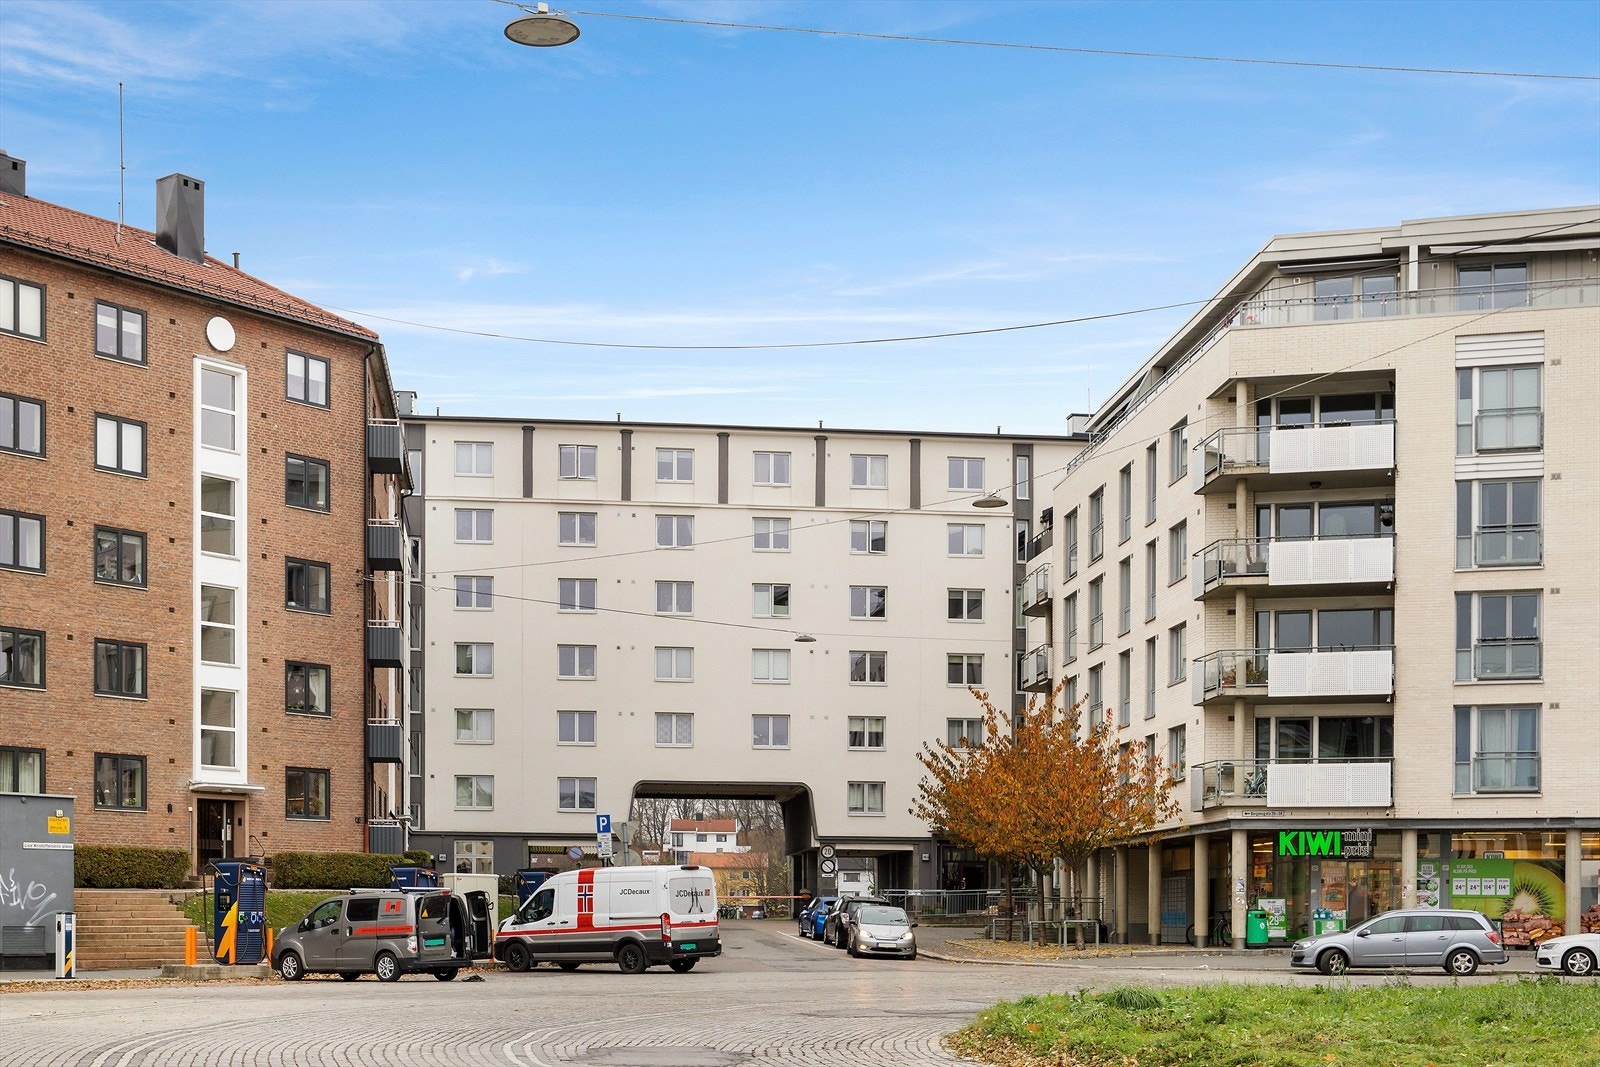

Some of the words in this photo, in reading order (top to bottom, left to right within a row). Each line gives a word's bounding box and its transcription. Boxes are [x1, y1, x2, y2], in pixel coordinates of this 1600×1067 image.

[600, 817, 607, 831] P
[1344, 828, 1372, 842] mini
[1279, 831, 1341, 856] KIWI
[1344, 841, 1370, 858] pris
[675, 889, 704, 897] JCDecaux
